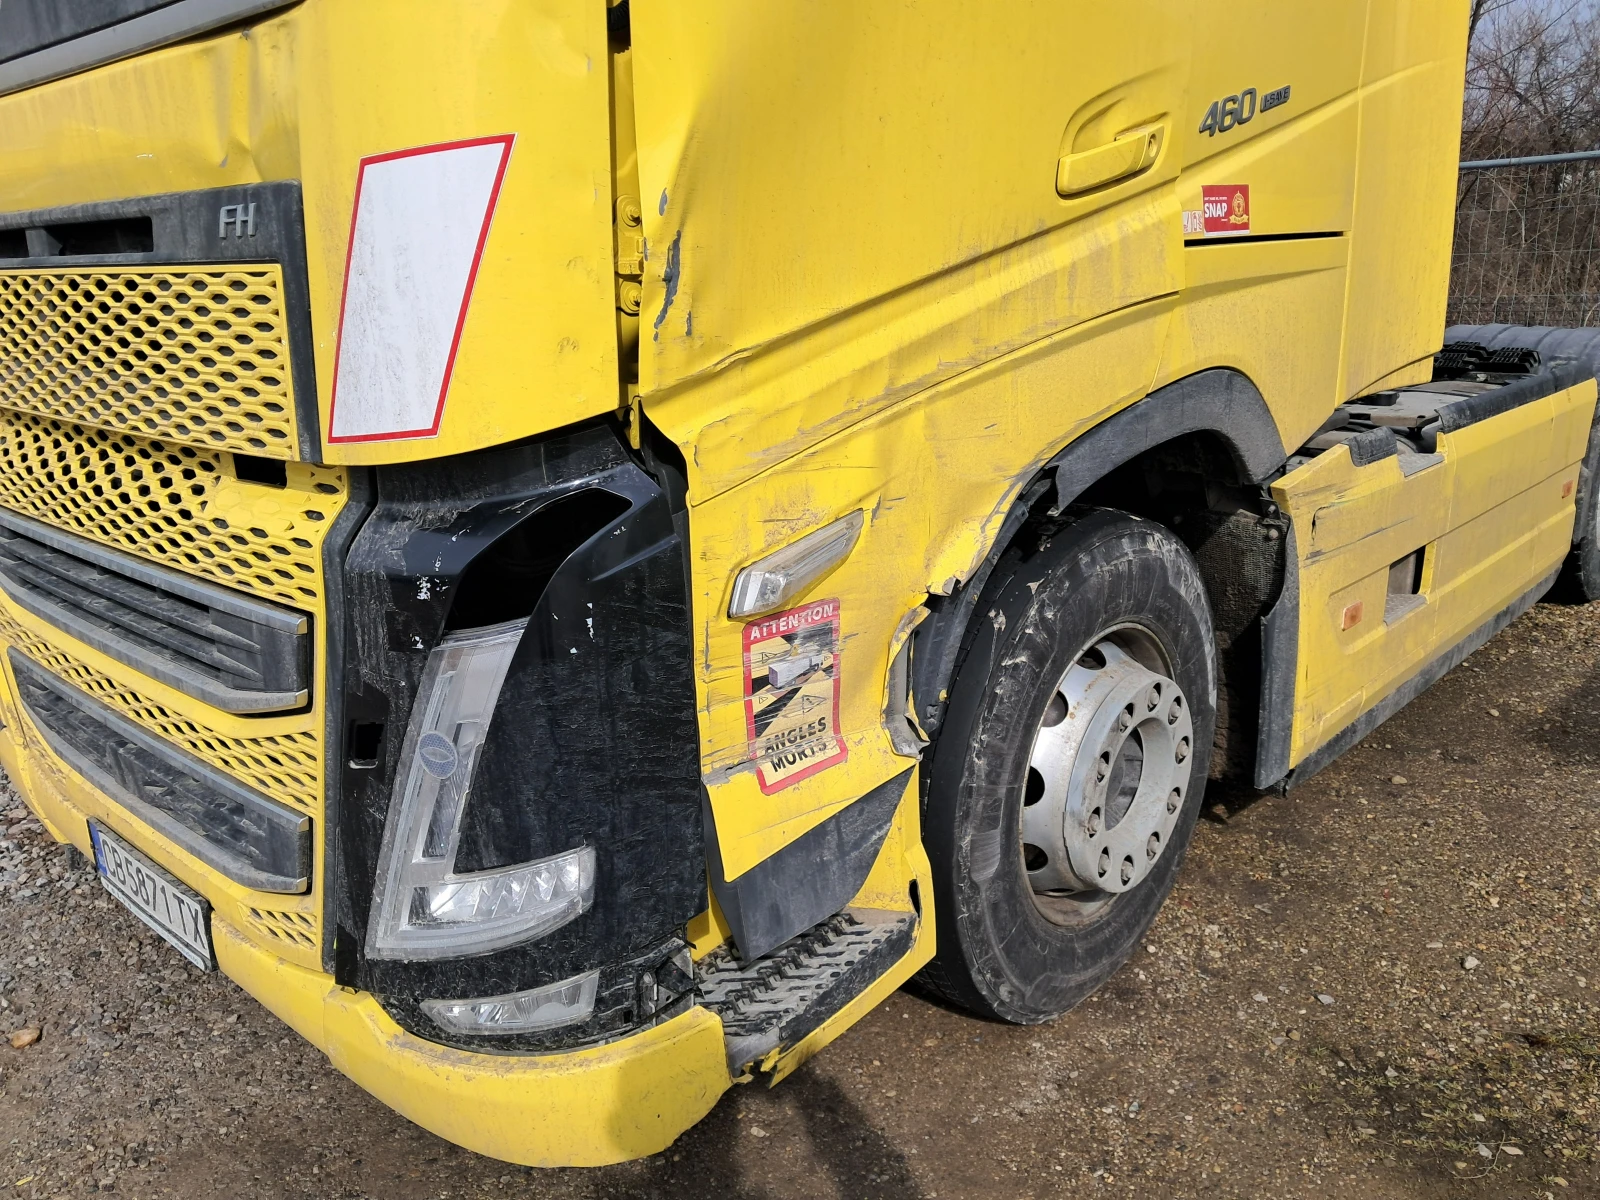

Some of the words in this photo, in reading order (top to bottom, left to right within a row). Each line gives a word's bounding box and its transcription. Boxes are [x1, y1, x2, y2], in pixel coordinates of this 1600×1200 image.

[1199, 87, 1257, 137] 460
[1262, 87, 1290, 109] I-SAVE
[219, 202, 257, 239] FH
[1204, 202, 1228, 218] SNAP
[750, 603, 834, 640] ATTENTION
[764, 716, 827, 755] ANGLES
